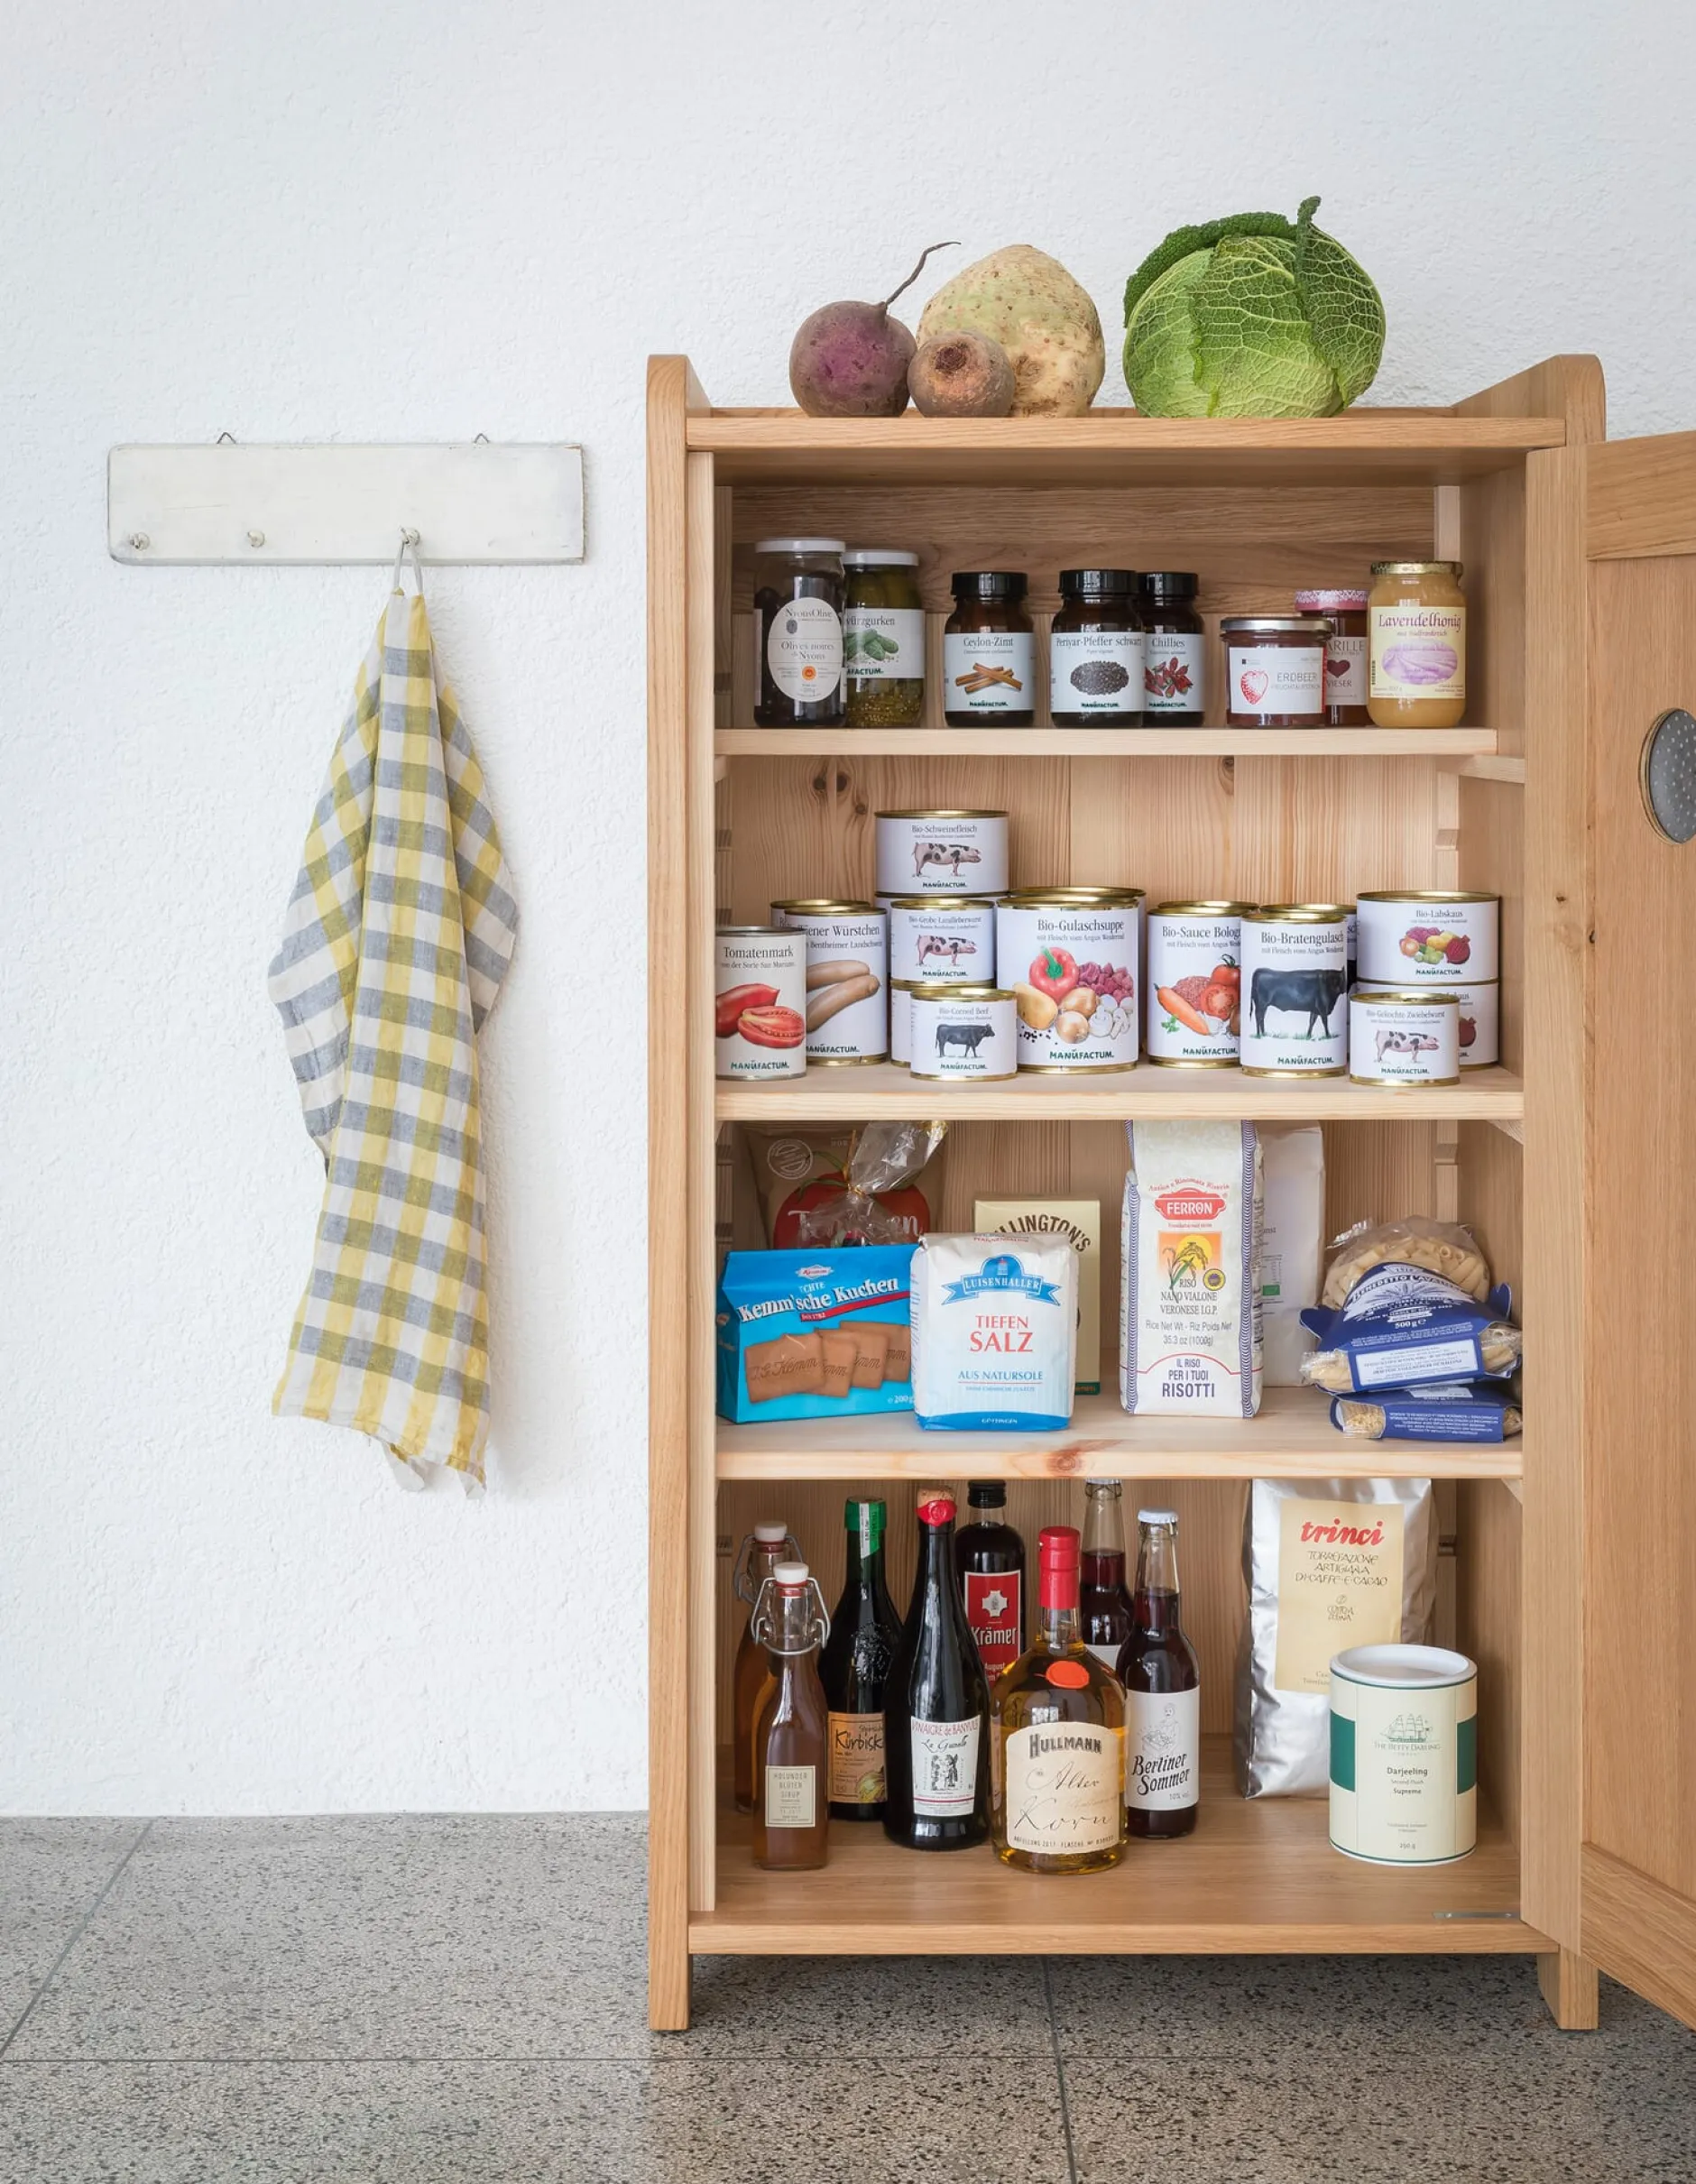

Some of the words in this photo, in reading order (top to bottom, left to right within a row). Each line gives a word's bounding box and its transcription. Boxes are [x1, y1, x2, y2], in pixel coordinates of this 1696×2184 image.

[1379, 613, 1462, 633] Lavendelhonig
[963, 637, 1013, 650] Ceylon-Zimt
[1152, 637, 1185, 648] Chillies
[1326, 640, 1365, 651] ARILLE
[1277, 672, 1317, 683] ERDBEER
[1415, 909, 1463, 918] Bio-Labskaus
[798, 925, 829, 936] ener
[833, 924, 880, 936] Würstchen
[1037, 919, 1124, 934] Bio-Gulaschsuppe
[1162, 926, 1210, 939] Bio-Sauce
[1213, 926, 1240, 941] Bolog
[1261, 931, 1344, 946] Bio-Bratengulasch
[724, 945, 794, 958] Tomatenmark
[1166, 1202, 1213, 1215] FERRON
[965, 1276, 1040, 1291] LUISENHALLER
[1179, 1278, 1196, 1287] RISO
[738, 1293, 832, 1323] Kemm'sche
[833, 1277, 899, 1304] Kuchen
[1184, 1292, 1218, 1302] VIALONE
[1160, 1304, 1199, 1315] VERONESE
[975, 1314, 1028, 1329] TIEFEN
[1146, 1321, 1160, 1330] Rice
[1162, 1321, 1174, 1330] Net
[1203, 1321, 1220, 1330] Poids
[1221, 1320, 1231, 1330] Net
[1395, 1321, 1411, 1329] 500
[970, 1331, 1034, 1353] SALZ
[1163, 1335, 1179, 1345] 35.3
[1180, 1337, 1188, 1345] oz
[1177, 1359, 1184, 1368] IL
[1185, 1359, 1201, 1368] RISO
[957, 1370, 979, 1380] AUS
[982, 1370, 1043, 1380] NATURSOLE
[1169, 1370, 1184, 1381] PER
[1192, 1370, 1209, 1381] TUOI
[1163, 1383, 1215, 1398] RISOTTI
[1301, 1518, 1385, 1545] trinci
[1308, 1551, 1378, 1564] TORREFAZIONE
[1314, 1563, 1369, 1574] ARTIGIANA
[971, 1626, 1017, 1646] Krämer
[835, 1728, 885, 1751] Kürbisk
[1029, 1733, 1102, 1760] HULLMANN
[1133, 1753, 1188, 1776] Berliner
[1387, 1767, 1428, 1777] Darjeeling
[1137, 1768, 1190, 1796] Sommer
